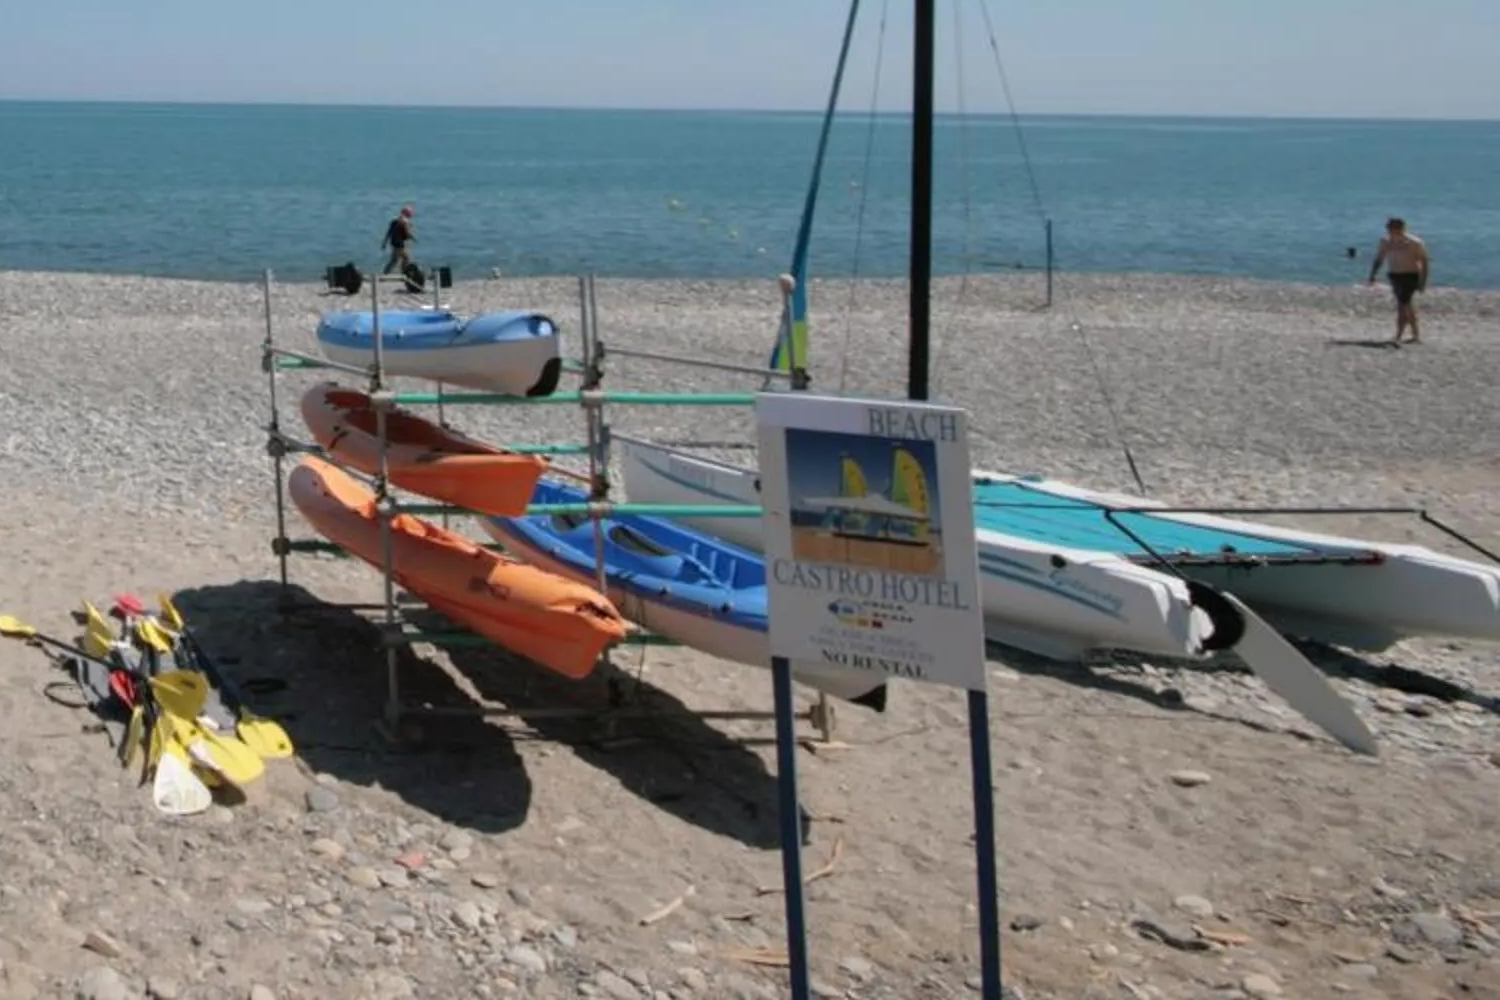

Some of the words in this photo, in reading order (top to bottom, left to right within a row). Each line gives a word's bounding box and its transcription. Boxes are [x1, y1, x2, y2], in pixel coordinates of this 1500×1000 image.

[867, 408, 957, 442] BEACH
[773, 559, 874, 597] CASTRO
[881, 573, 970, 610] HOTEL
[822, 648, 848, 665] NO
[852, 653, 929, 680] RENTAL
